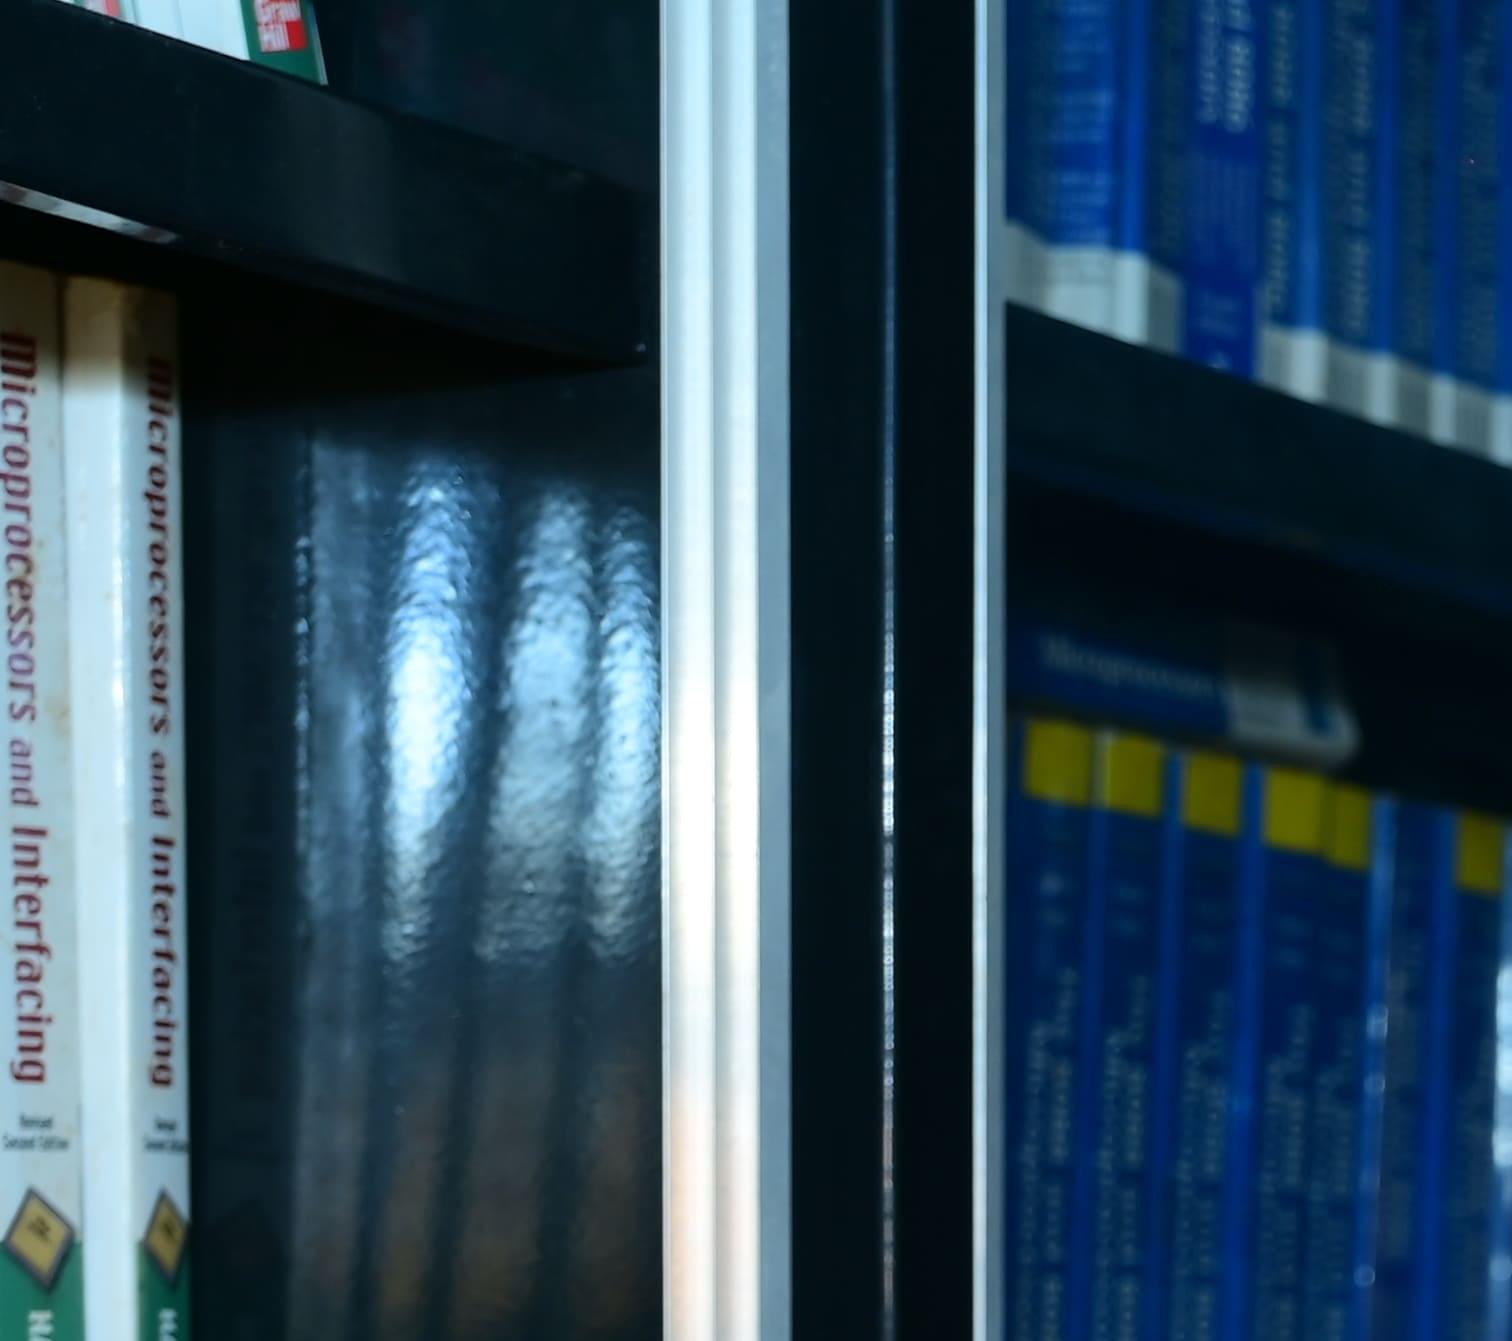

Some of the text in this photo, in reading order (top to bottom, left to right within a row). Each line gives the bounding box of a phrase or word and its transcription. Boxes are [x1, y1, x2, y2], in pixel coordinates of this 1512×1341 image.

[143, 356, 176, 737] Microprocessors
[0, 332, 52, 1086] Microprocessors and Interfacing
[150, 751, 171, 818] and
[150, 837, 178, 1089] Interfacing
